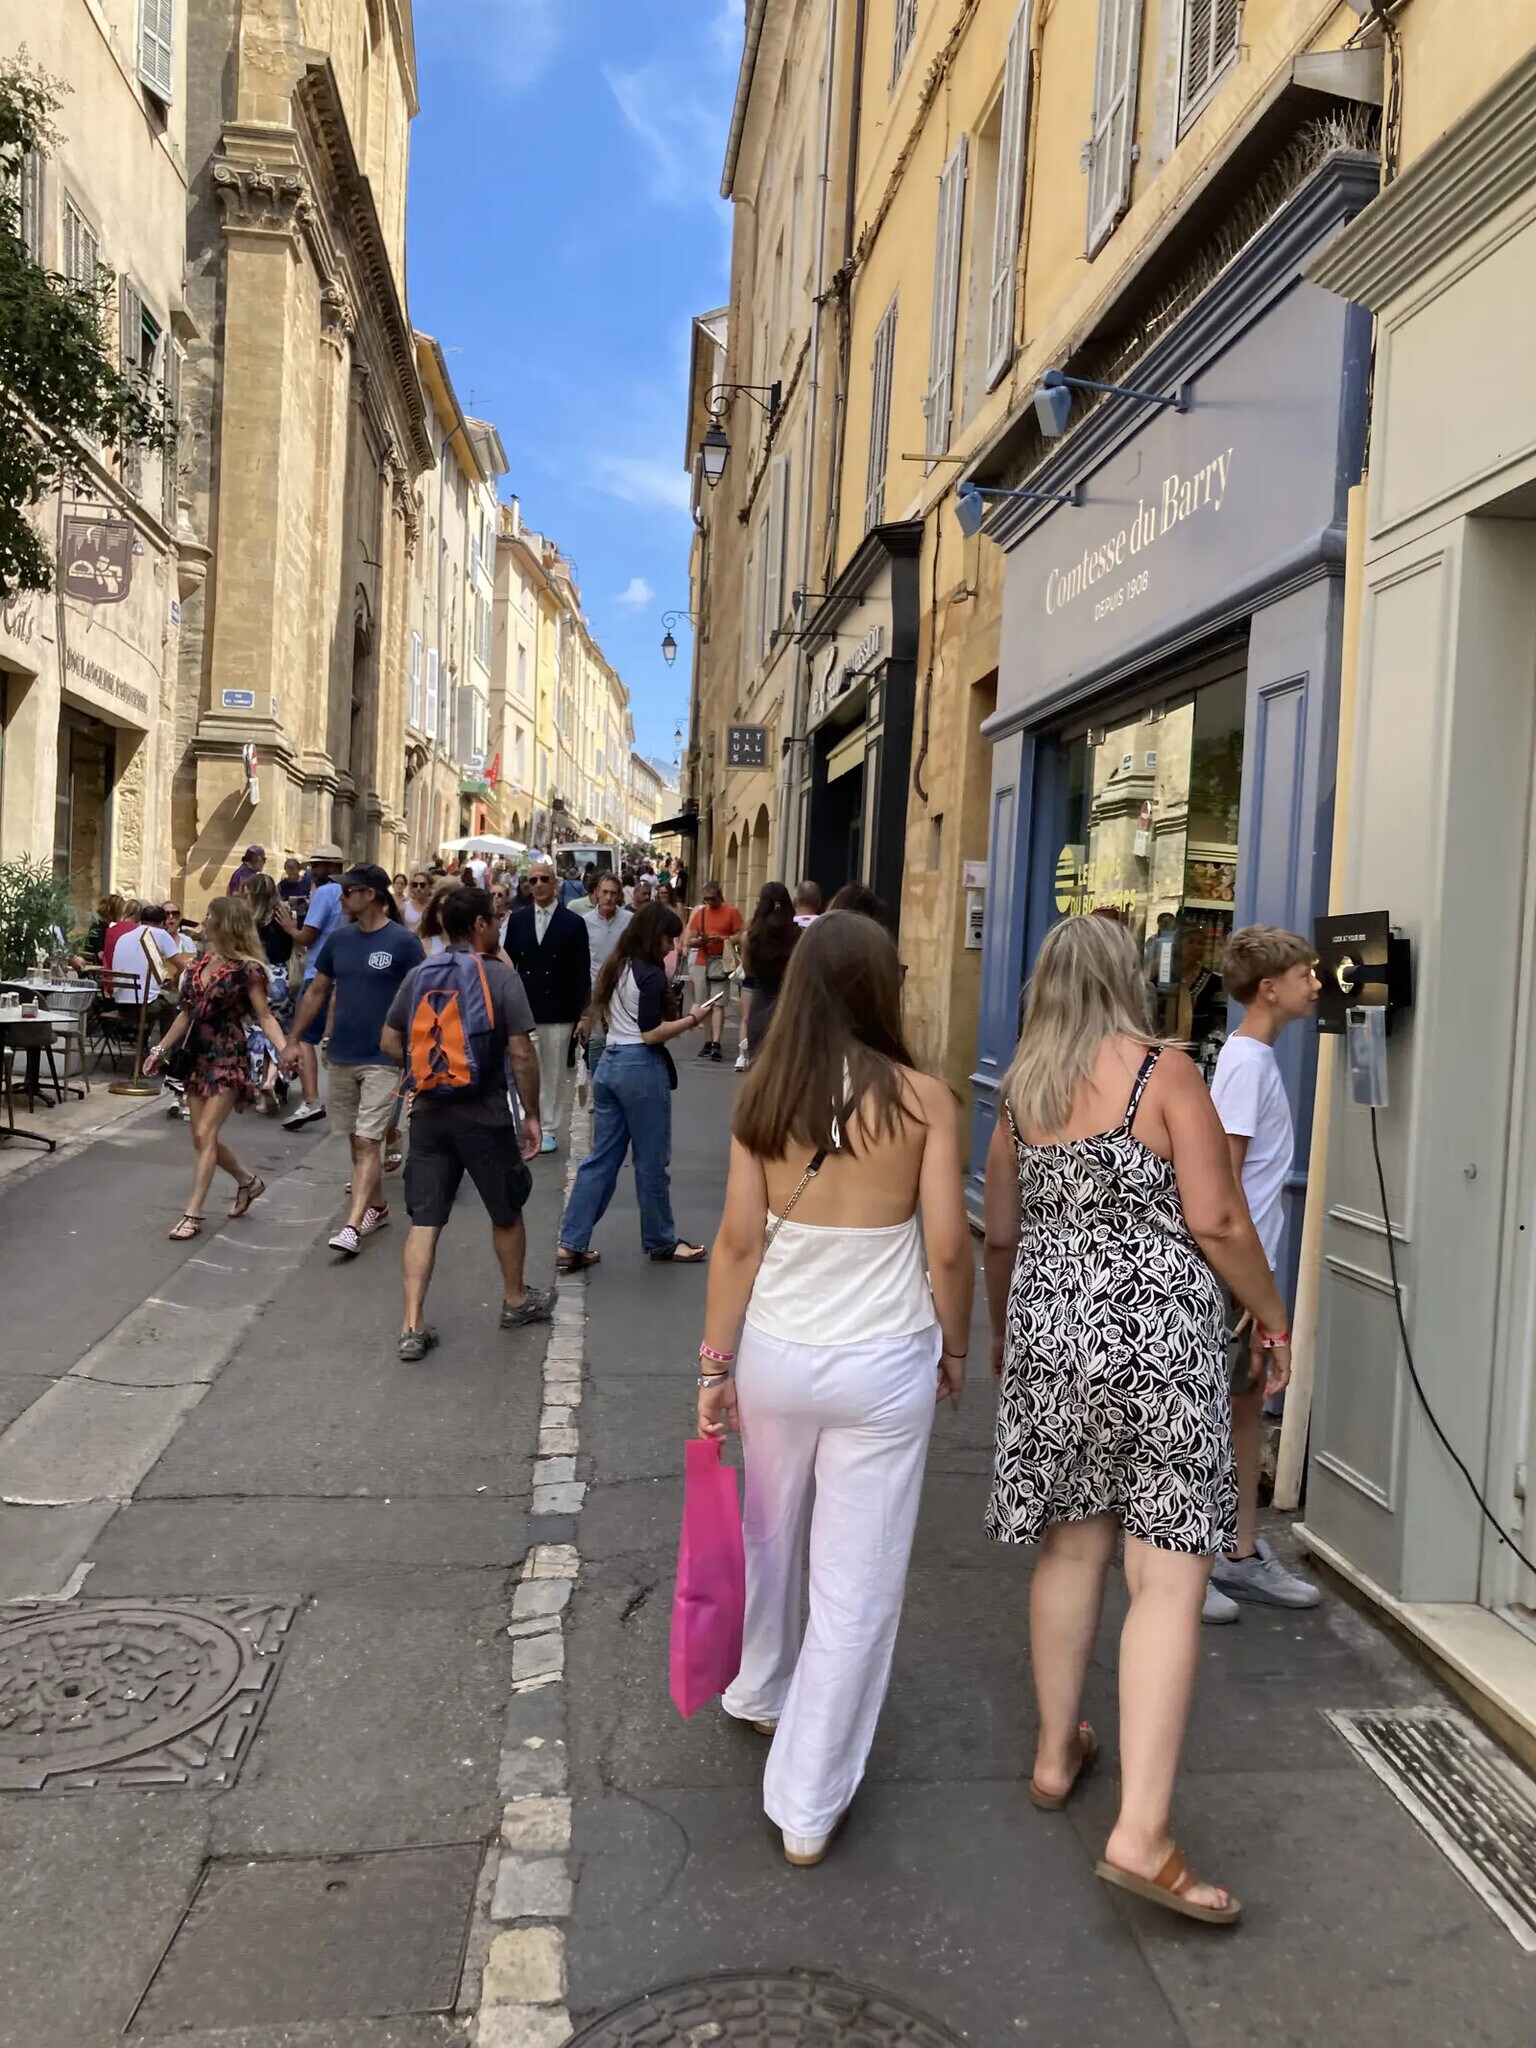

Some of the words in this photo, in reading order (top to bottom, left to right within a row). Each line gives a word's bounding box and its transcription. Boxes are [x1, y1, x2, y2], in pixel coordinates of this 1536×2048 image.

[1045, 530, 1127, 616] Comtesse
[1130, 498, 1156, 555] du
[1159, 447, 1235, 535] Barry
[1094, 587, 1124, 621] DEPUIS
[1126, 569, 1149, 601] 1908
[1078, 863, 1089, 886] LE
[370, 954, 388, 967] DEUS
